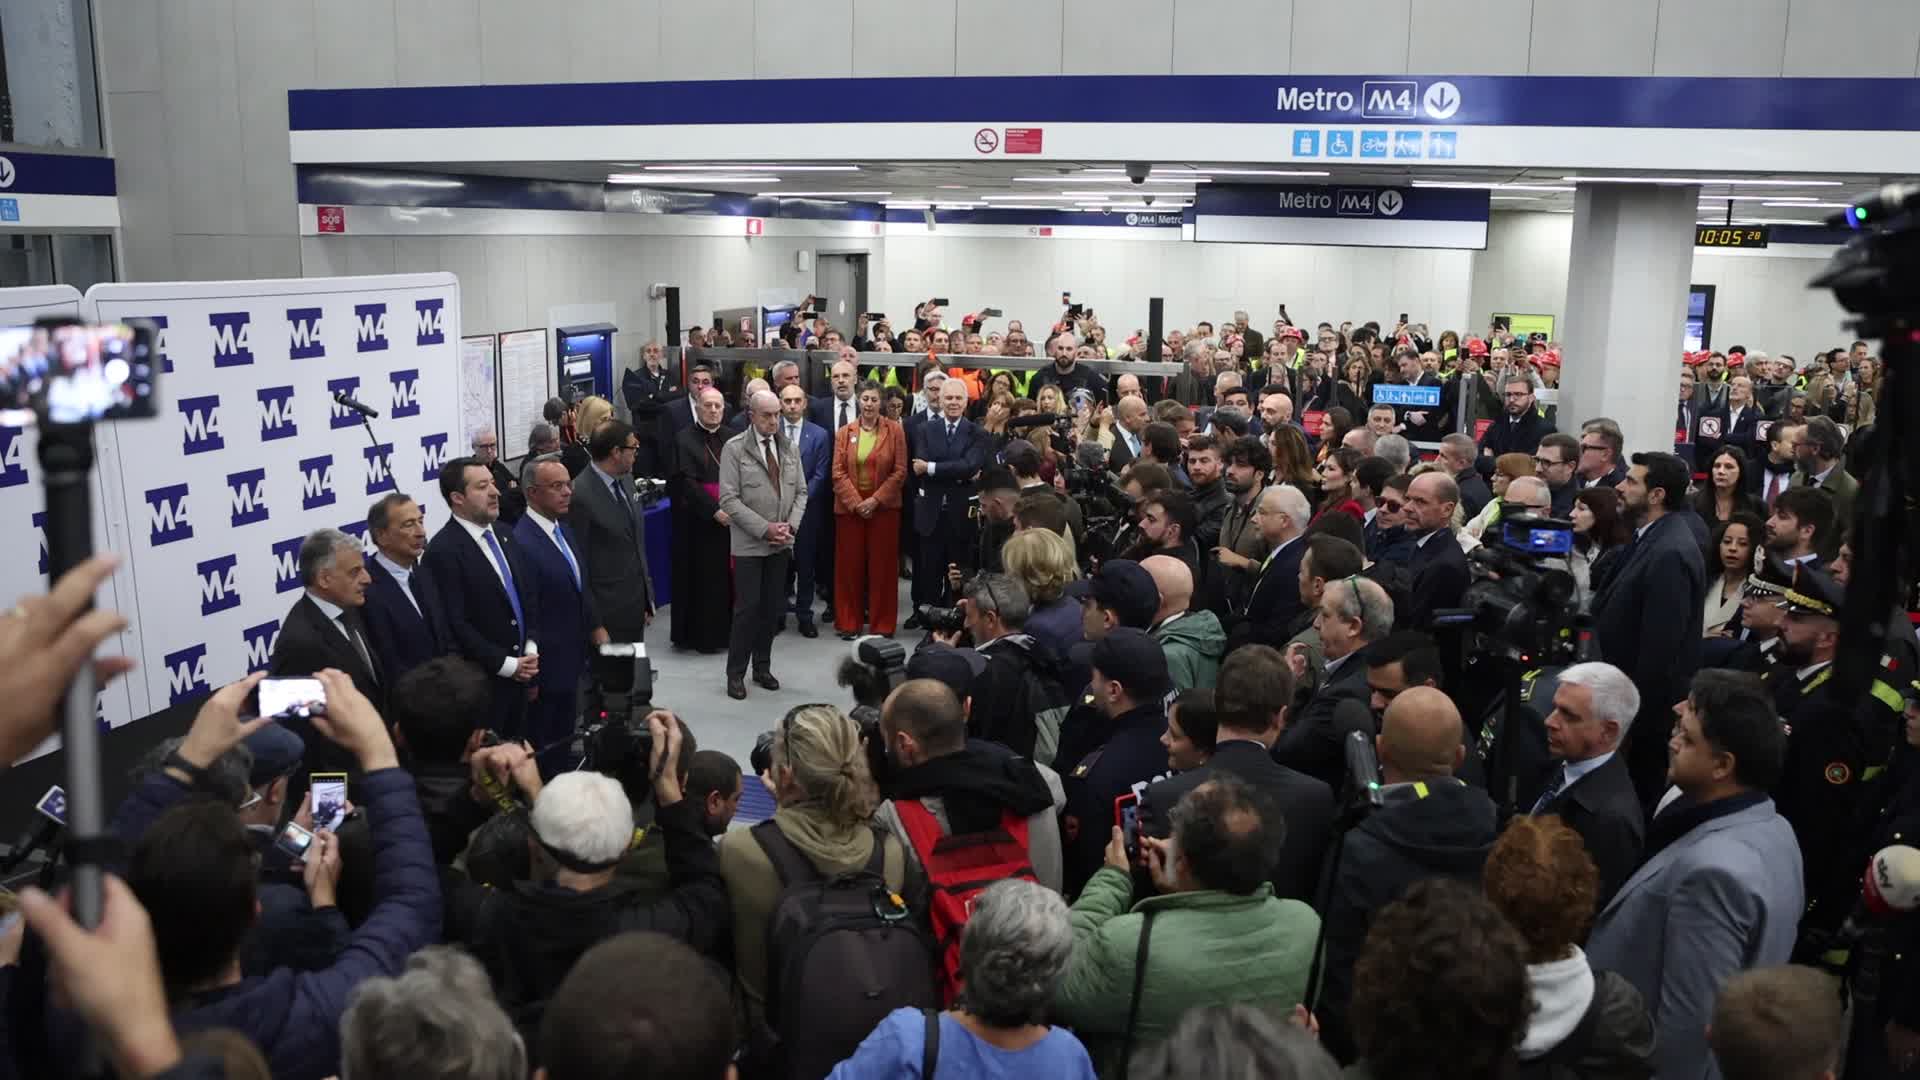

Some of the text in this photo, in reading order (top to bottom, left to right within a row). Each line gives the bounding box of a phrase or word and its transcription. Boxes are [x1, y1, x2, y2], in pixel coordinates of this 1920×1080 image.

[1277, 87, 1412, 112] Metro M4
[1279, 191, 1371, 210] Metro M4
[322, 215, 340, 225] SOS
[1141, 215, 1155, 224] M4
[1699, 230, 1761, 245] 10:05 28
[287, 317, 325, 350] M4
[355, 313, 389, 343] M4
[416, 307, 445, 337] M4
[209, 322, 252, 358] M4
[390, 378, 421, 410] M4
[179, 405, 224, 444] M4
[258, 396, 297, 432] M4
[421, 441, 449, 473] M4
[227, 479, 269, 517] M4
[300, 464, 336, 501] M4
[147, 494, 193, 536] M4
[198, 564, 240, 606] M4
[165, 654, 209, 698] M4
